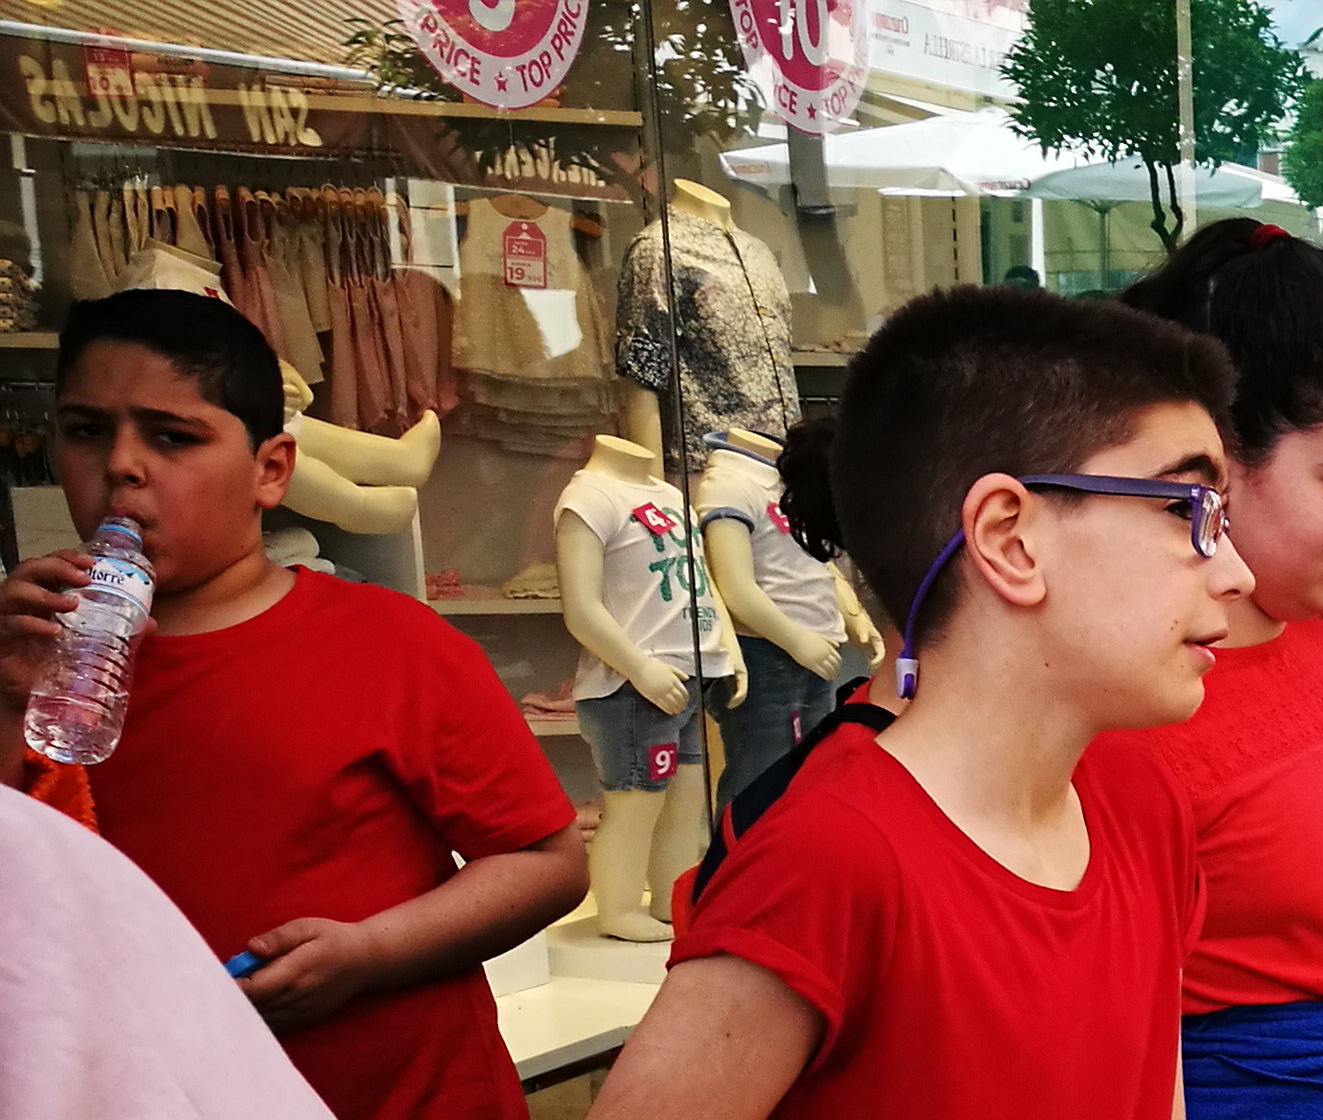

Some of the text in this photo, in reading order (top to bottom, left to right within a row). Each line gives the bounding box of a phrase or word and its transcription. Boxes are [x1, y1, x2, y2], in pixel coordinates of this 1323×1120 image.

[418, 10, 482, 86] PRICE
[515, 0, 584, 92] TOP PRIC
